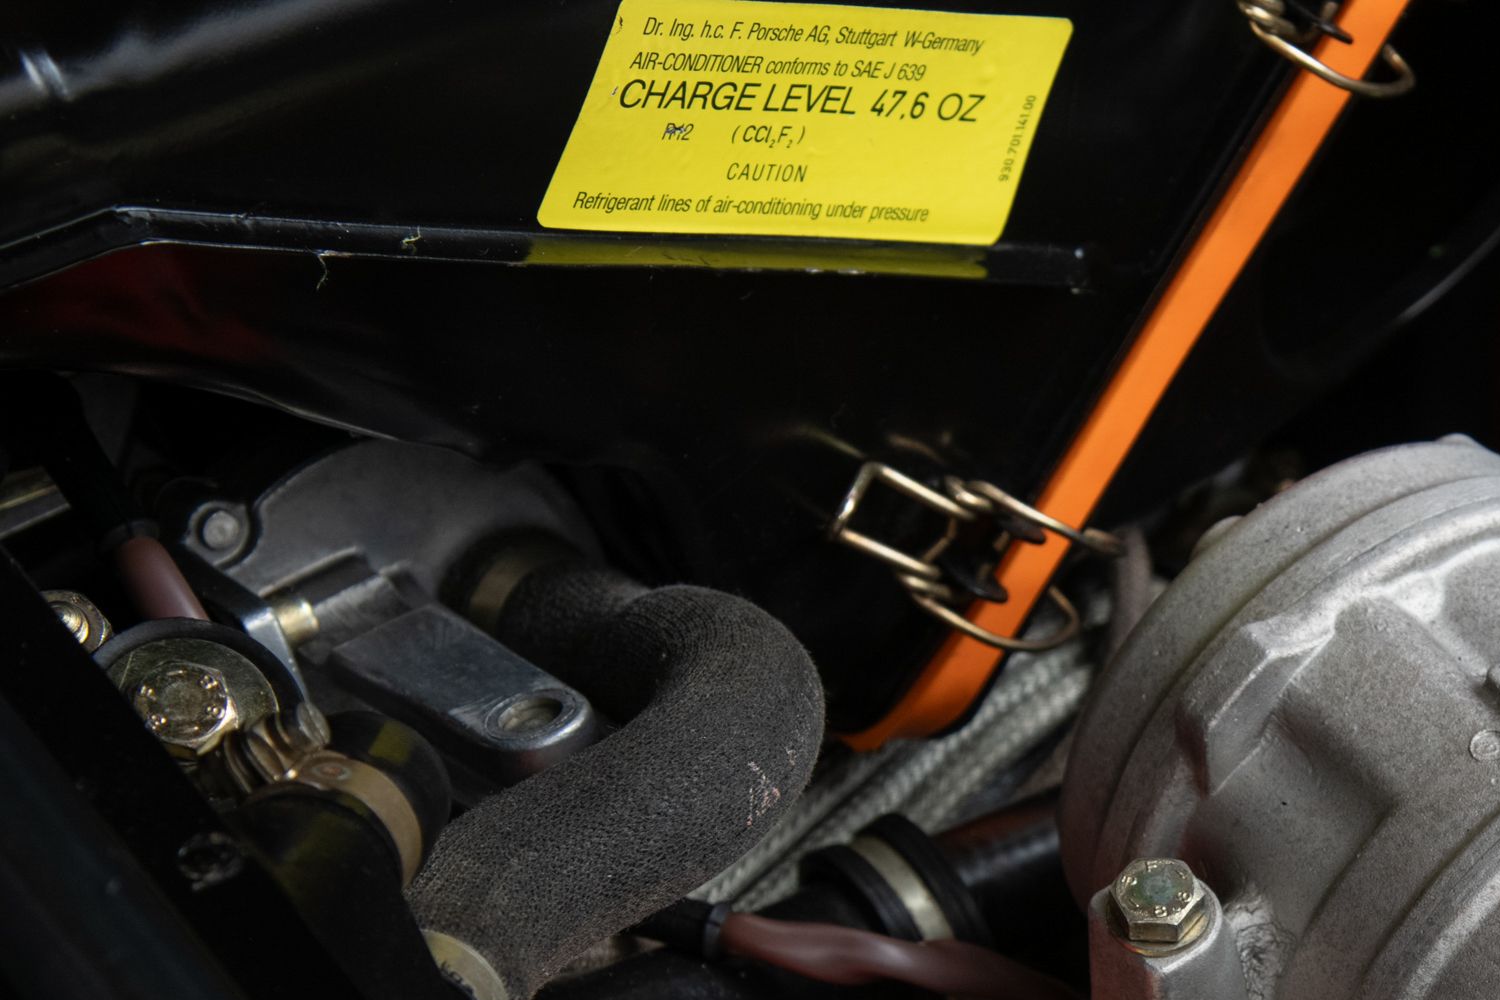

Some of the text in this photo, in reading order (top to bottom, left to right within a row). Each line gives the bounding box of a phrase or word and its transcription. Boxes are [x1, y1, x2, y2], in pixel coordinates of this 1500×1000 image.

[643, 17, 985, 56] Dr. Ing. h.c. F. Porsche AG, Stuttgart W-Germany
[629, 52, 926, 81] AIR-CONDITIONER conforms to SAE J 639
[619, 79, 986, 122] CHARGE LEVEL 47,6 OZ
[726, 163, 808, 182] CAUTION
[573, 192, 929, 223] Refrigerant lines of air-conditioning under pressure
